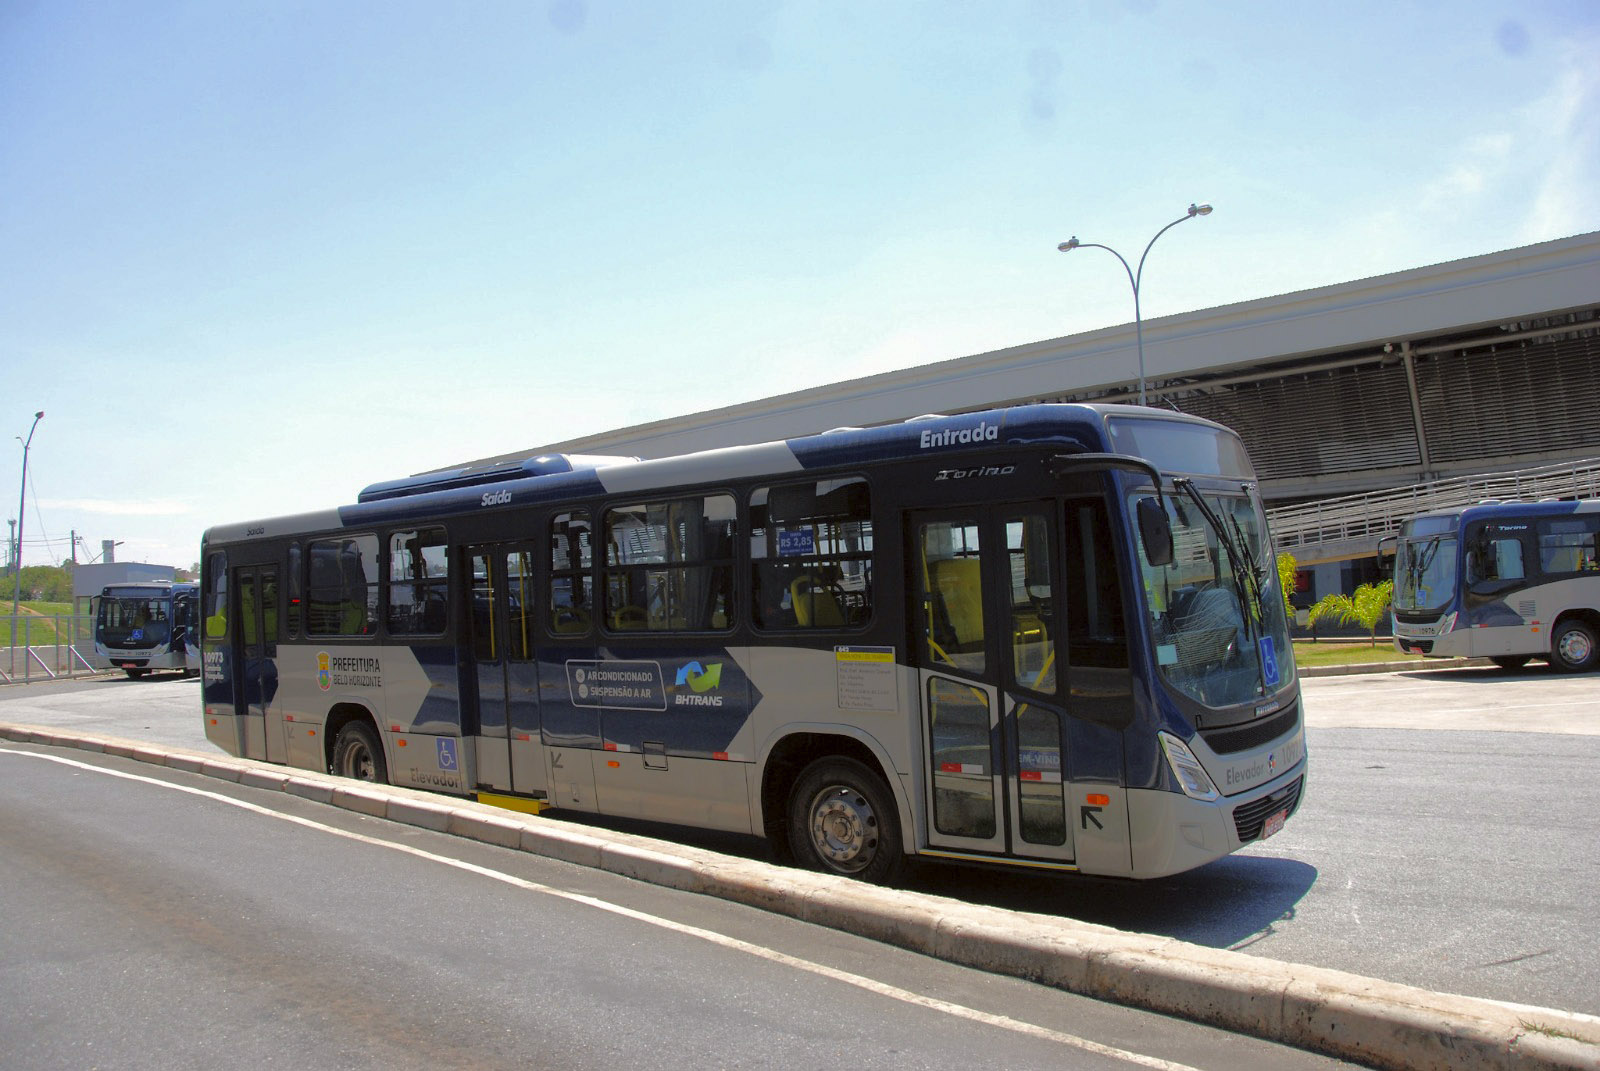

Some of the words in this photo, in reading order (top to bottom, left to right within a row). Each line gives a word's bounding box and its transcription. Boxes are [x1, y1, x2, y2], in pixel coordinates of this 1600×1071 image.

[920, 421, 998, 449] Entrada
[934, 465, 1016, 481] Torino
[481, 489, 512, 507] Saída
[793, 536, 812, 547] 2,85
[332, 657, 381, 673] PREFEITURA
[333, 674, 348, 686] BELO
[348, 675, 382, 687] HORIZONTE
[590, 686, 632, 698] SUSPENSÃO
[634, 688, 640, 698] A
[640, 688, 652, 699] AR
[675, 694, 724, 707] BHTRANS
[409, 767, 459, 789] Elevador
[1226, 760, 1264, 785] Elevador
